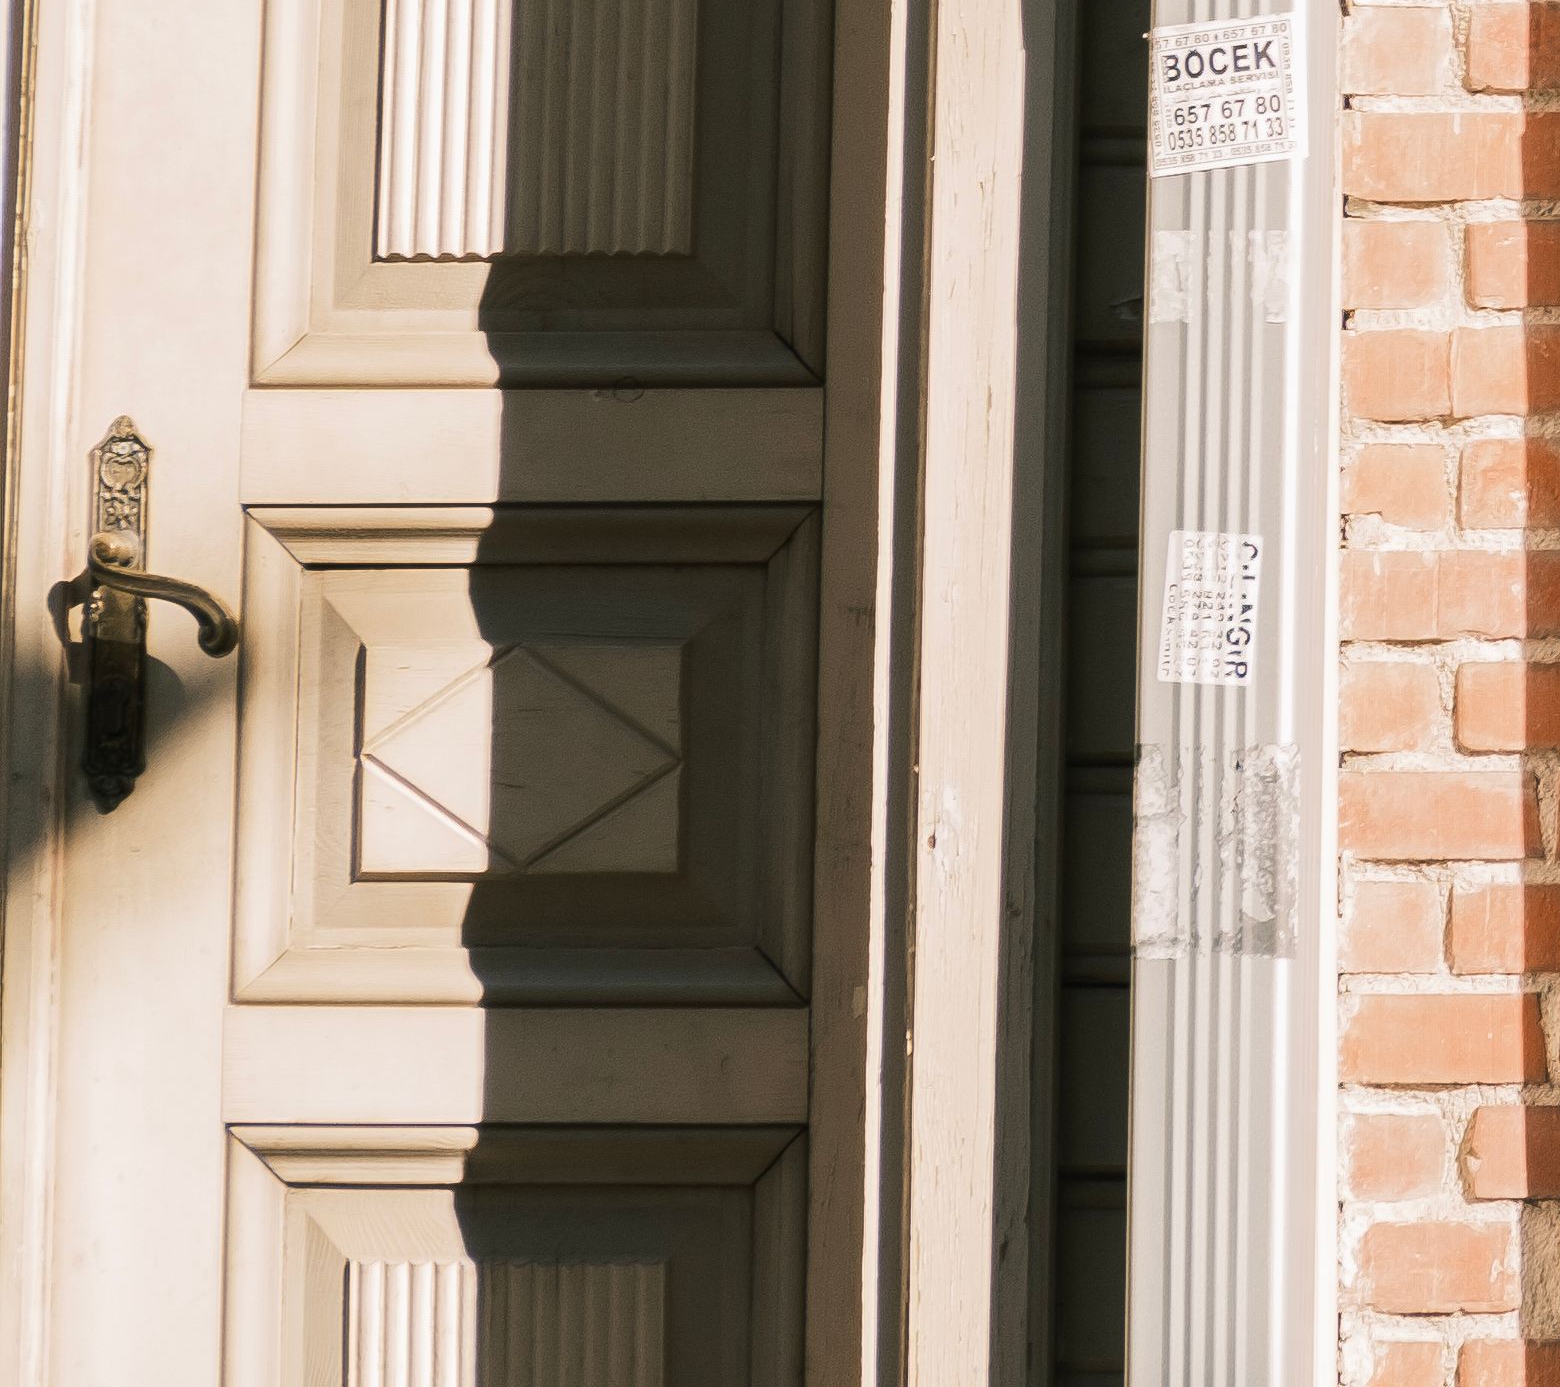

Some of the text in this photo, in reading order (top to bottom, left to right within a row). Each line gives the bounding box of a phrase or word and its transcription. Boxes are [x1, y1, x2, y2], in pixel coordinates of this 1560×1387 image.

[1174, 103, 1211, 126] 657
[1221, 99, 1245, 119] 67
[1255, 94, 1281, 115] 80
[1168, 127, 1203, 151] 0535
[1209, 122, 1236, 145] 858
[1241, 119, 1259, 141] 71
[1265, 116, 1284, 138] 33
